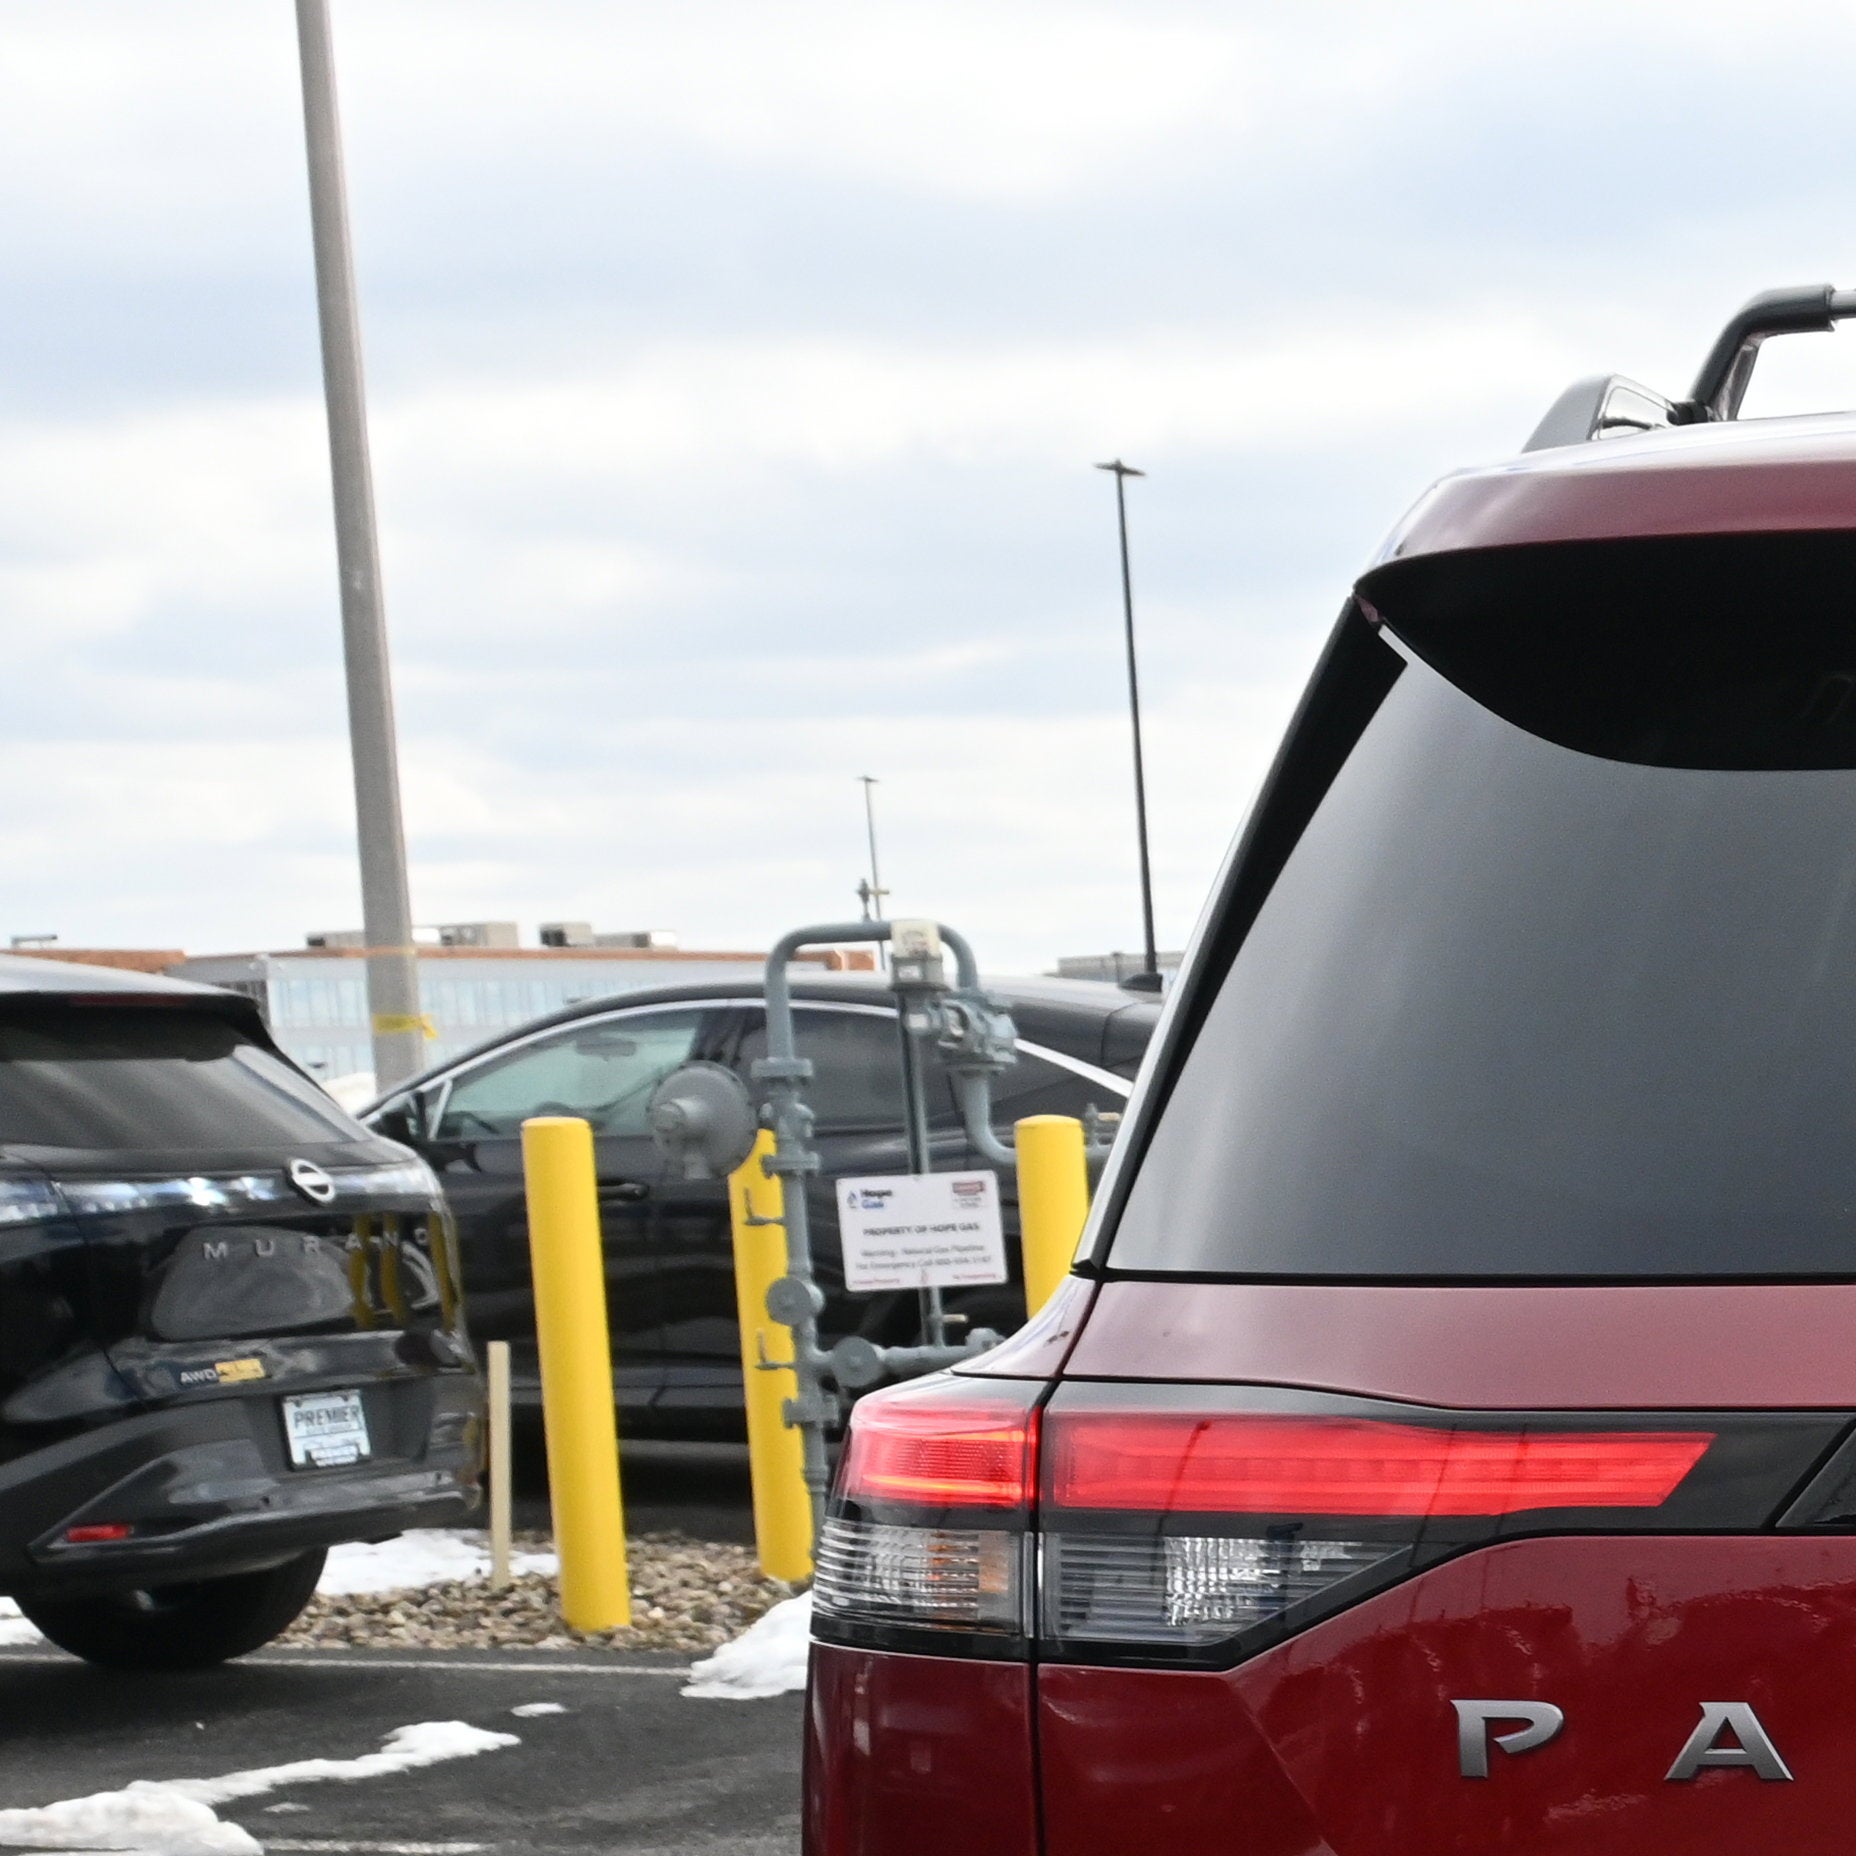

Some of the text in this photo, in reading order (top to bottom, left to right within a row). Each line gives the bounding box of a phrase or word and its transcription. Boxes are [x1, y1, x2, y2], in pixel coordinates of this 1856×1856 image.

[203, 1228, 429, 1260] MURANO
[181, 1368, 217, 1384] AWD
[293, 1405, 361, 1430] PREMIER
